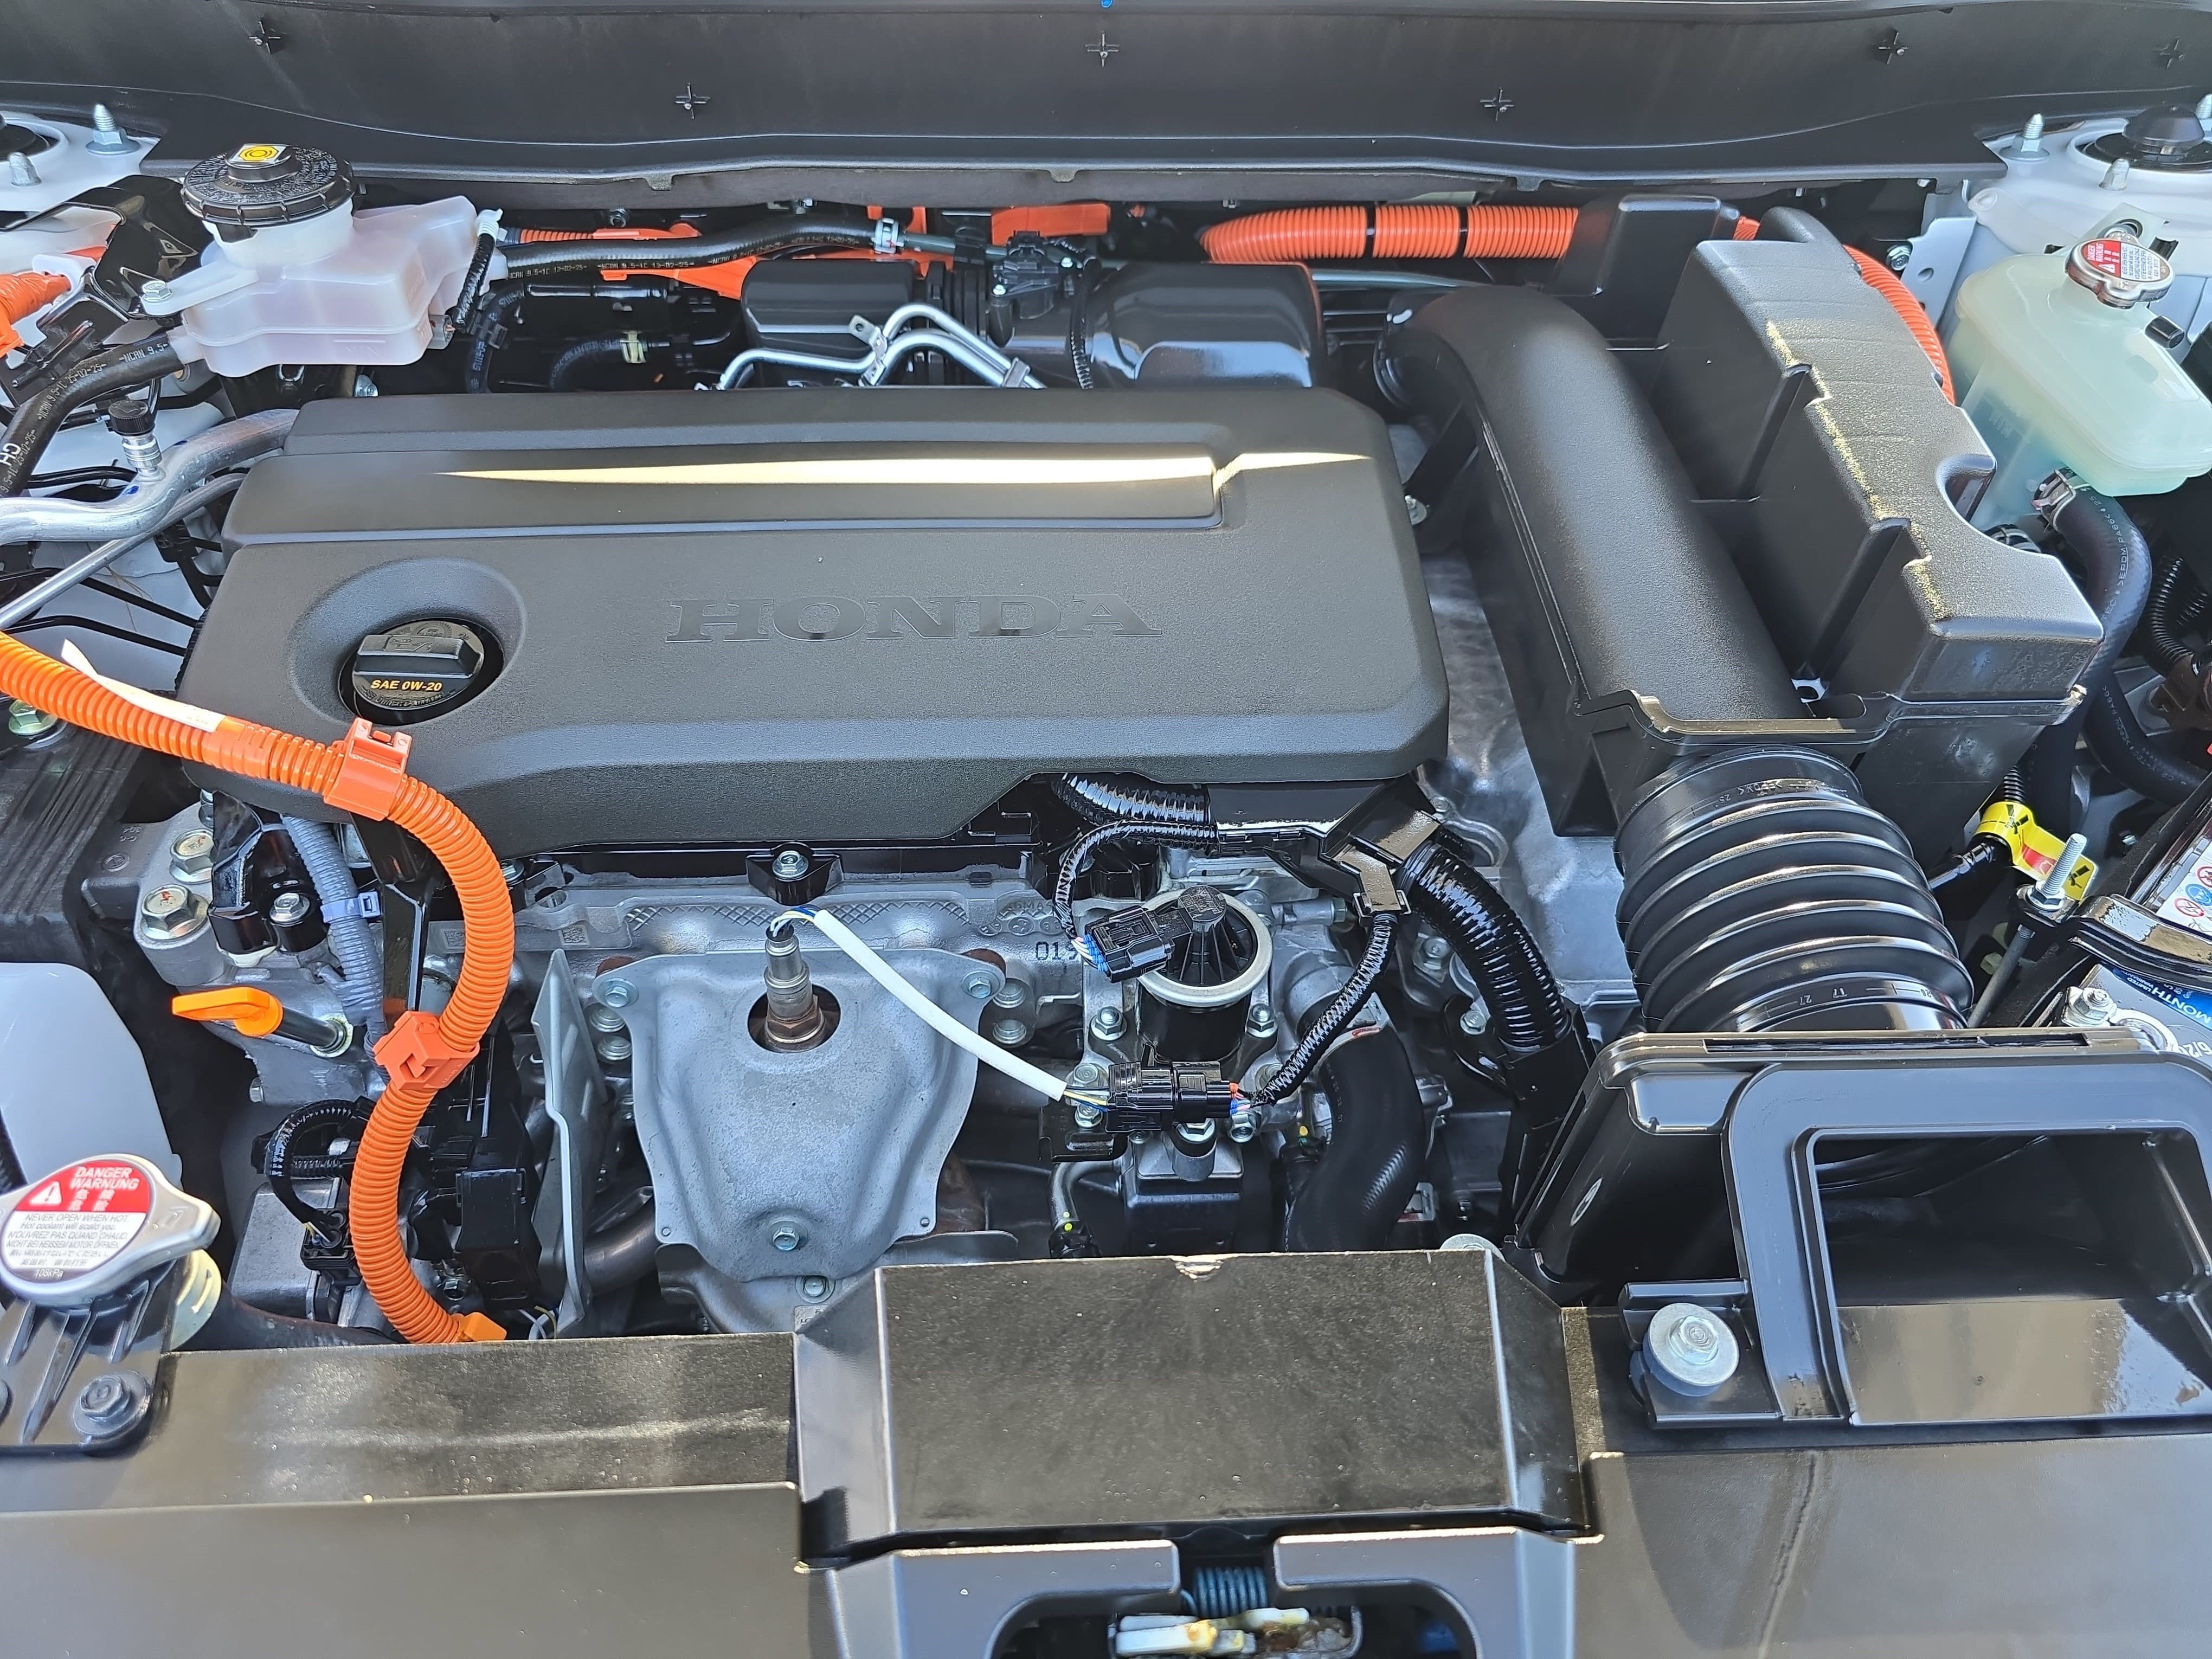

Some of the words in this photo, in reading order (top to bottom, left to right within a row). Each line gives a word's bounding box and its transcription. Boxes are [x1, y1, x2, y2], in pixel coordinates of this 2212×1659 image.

[664, 594, 1163, 644] HONDA
[370, 679, 400, 690] SAE
[402, 680, 442, 691] 0W-20
[2127, 977, 2152, 992] LIMITED
[2151, 987, 2212, 1024] MONTH
[74, 1167, 133, 1178] DANGER
[70, 1178, 140, 1190] WARNUNG
[68, 1231, 97, 1239] QUAND
